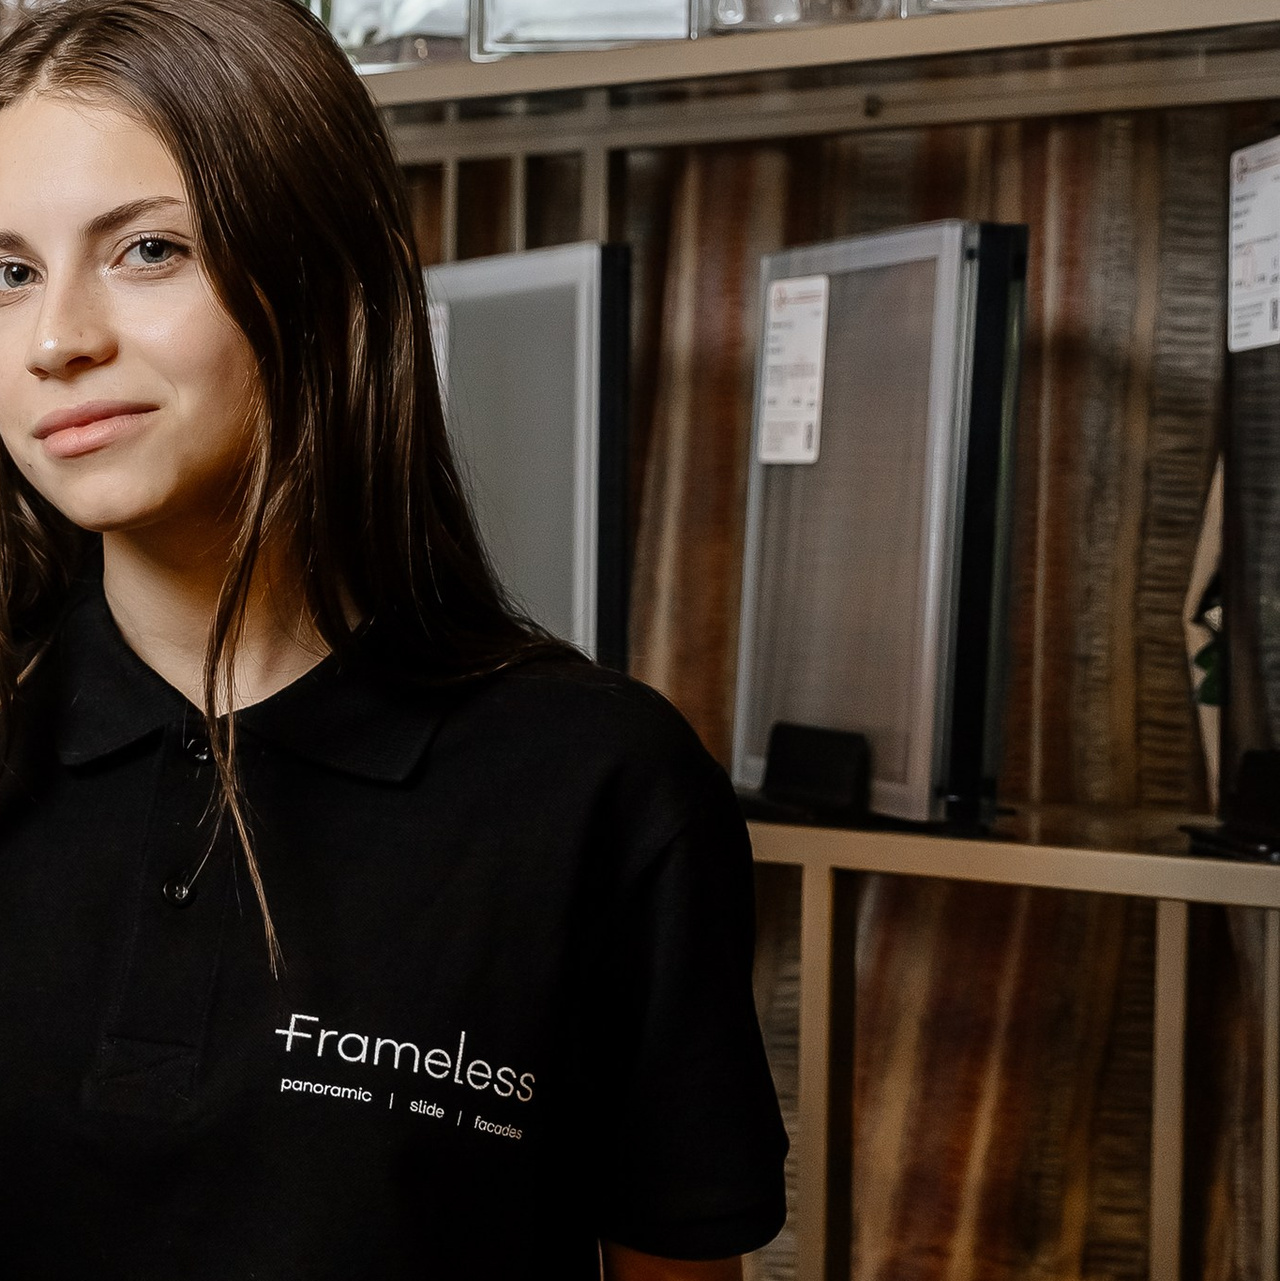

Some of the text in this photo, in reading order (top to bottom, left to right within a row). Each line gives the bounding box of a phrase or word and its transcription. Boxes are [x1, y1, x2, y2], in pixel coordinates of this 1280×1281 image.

[275, 1013, 536, 1102] Frameless
[280, 1077, 523, 1140] panoramic slide facades
